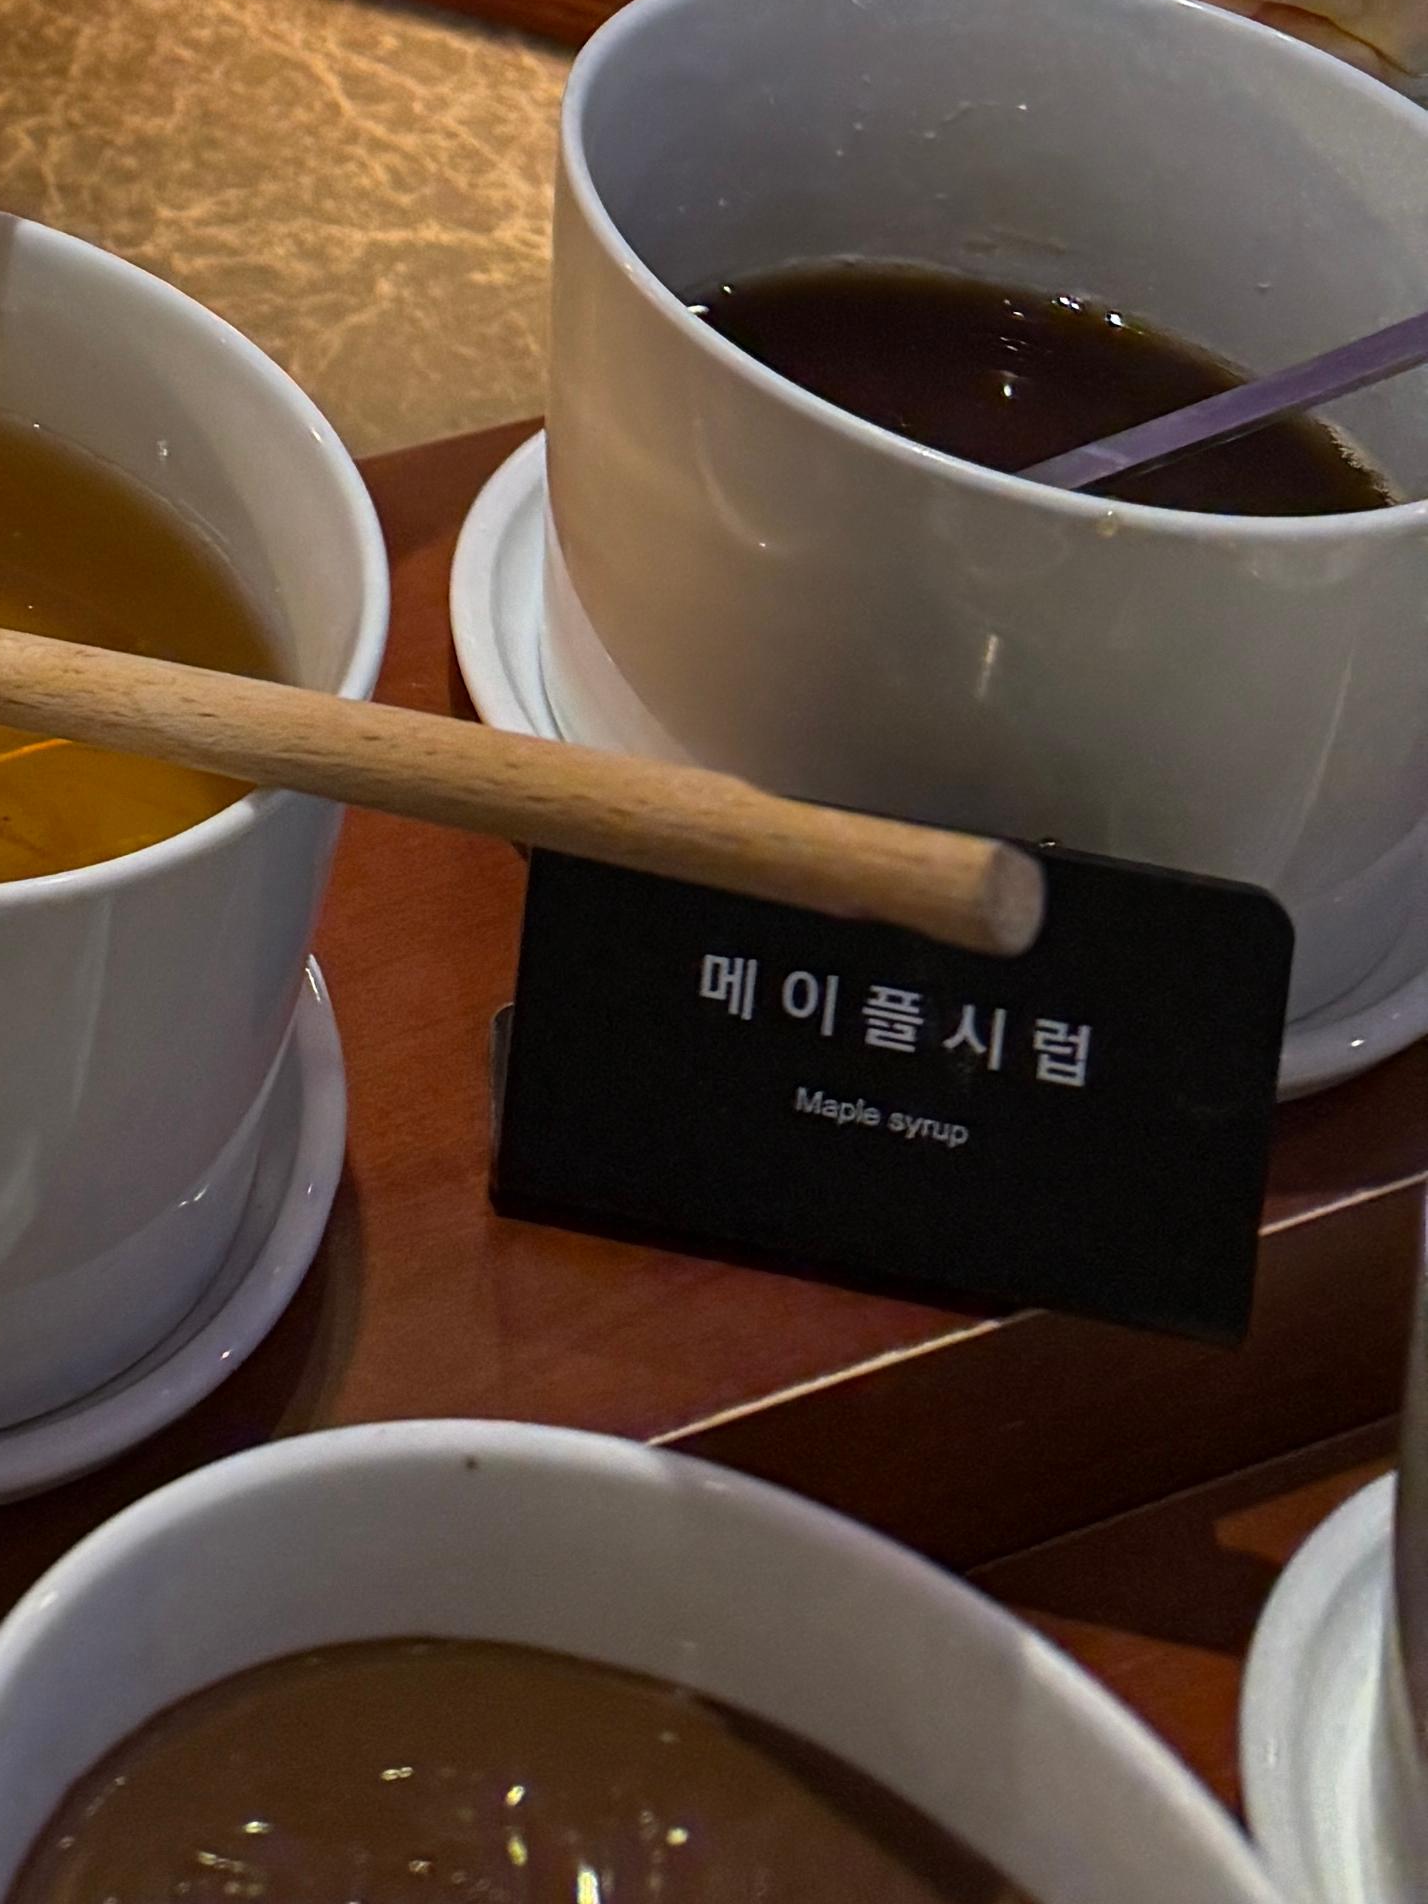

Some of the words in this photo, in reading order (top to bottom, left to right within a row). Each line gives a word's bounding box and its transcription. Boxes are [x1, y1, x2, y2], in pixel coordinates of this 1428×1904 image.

[700, 954, 1092, 1087] 메이플시럽
[794, 1085, 881, 1125] Maple
[887, 1109, 970, 1149] syrup
